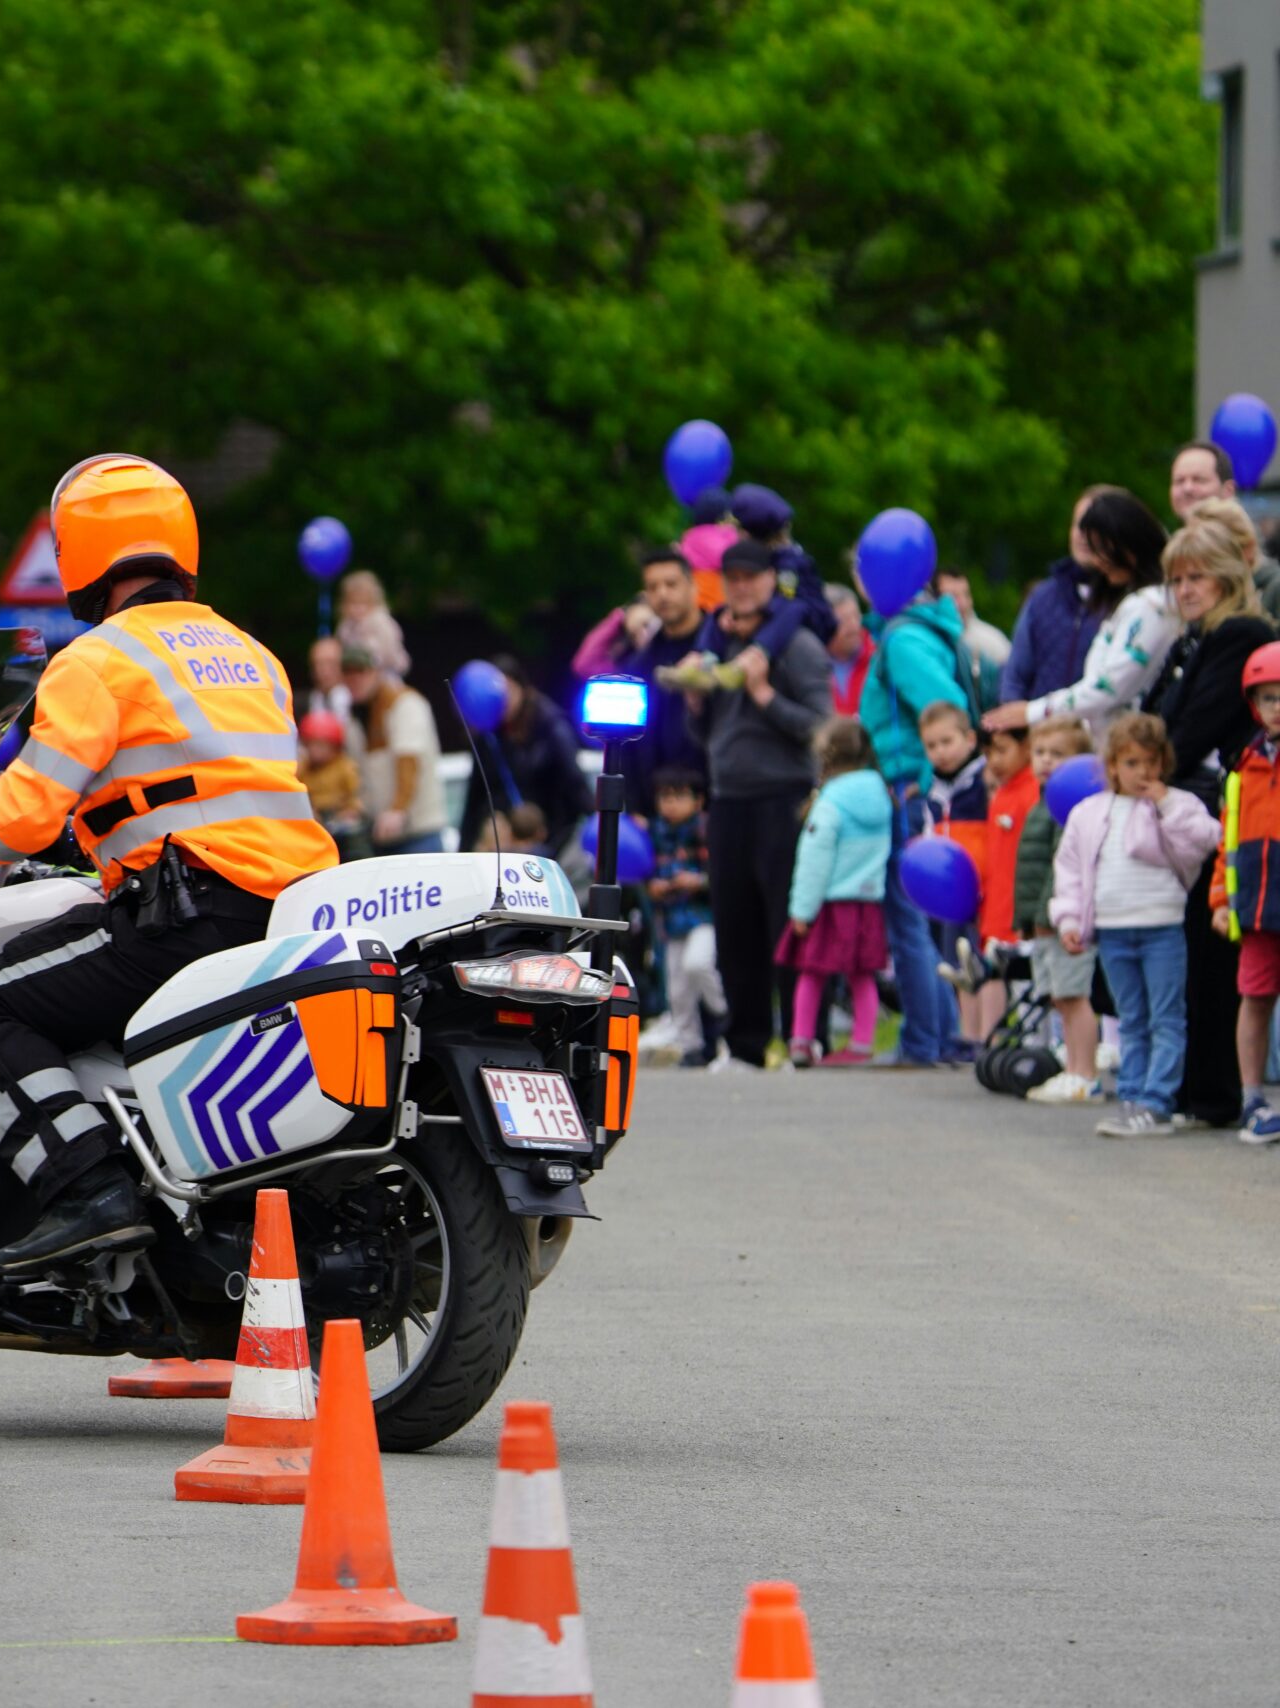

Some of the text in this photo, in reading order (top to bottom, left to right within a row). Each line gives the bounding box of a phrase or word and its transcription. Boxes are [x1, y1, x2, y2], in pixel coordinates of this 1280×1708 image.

[158, 624, 243, 652] Politie
[187, 656, 260, 685] Police
[347, 881, 442, 926] Politie
[259, 1013, 283, 1029] BMW
[533, 1108, 580, 1137] 115
